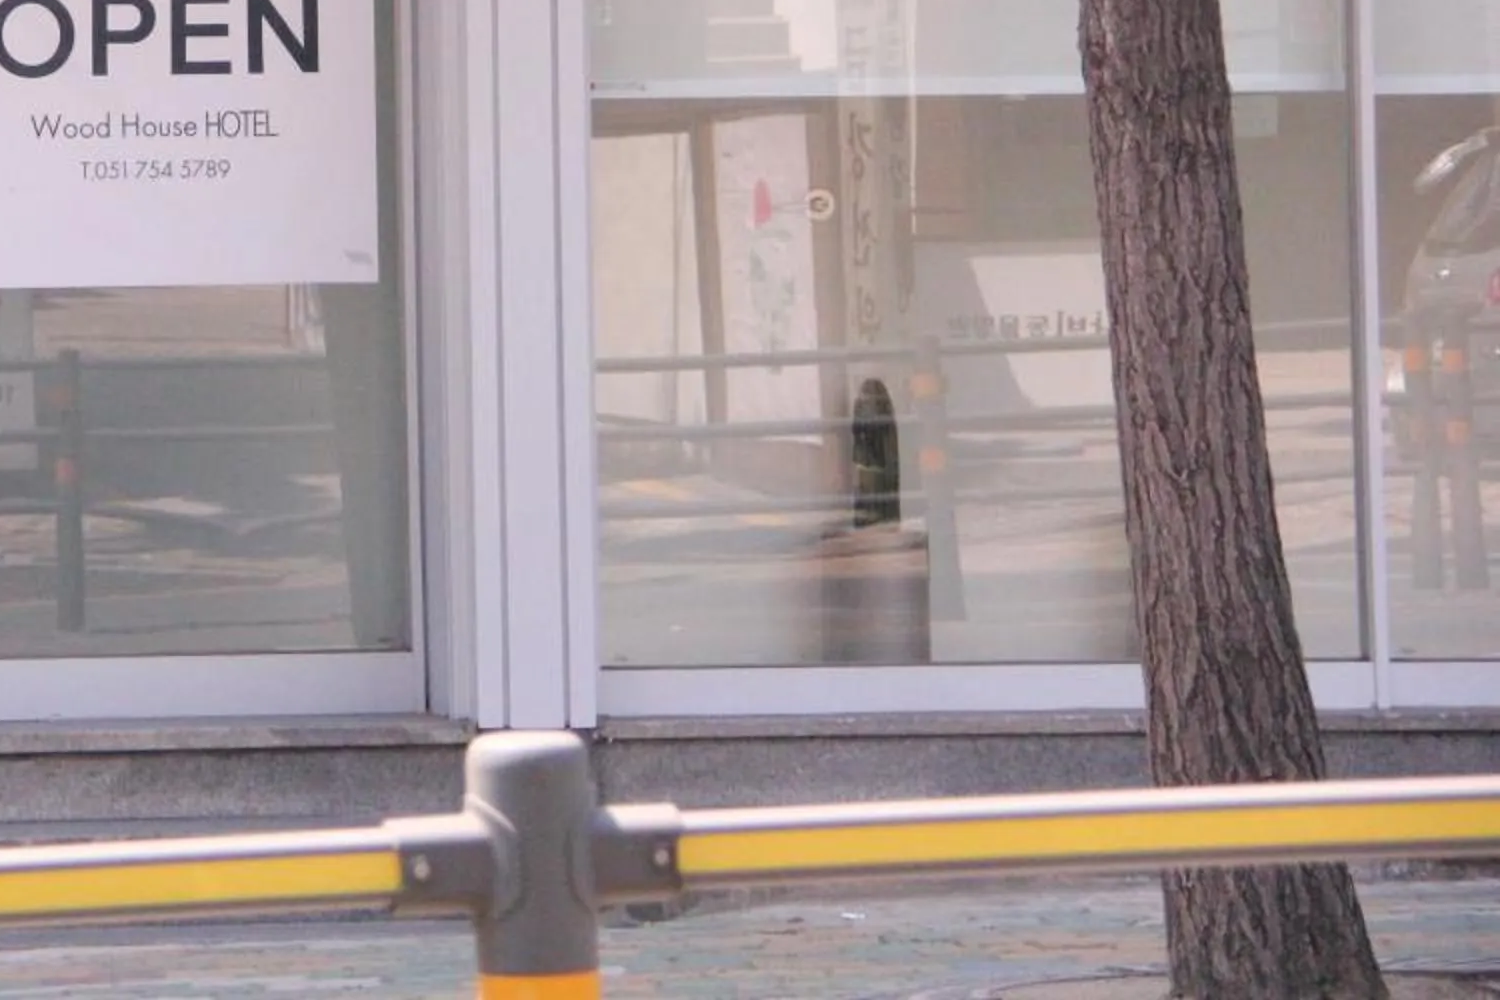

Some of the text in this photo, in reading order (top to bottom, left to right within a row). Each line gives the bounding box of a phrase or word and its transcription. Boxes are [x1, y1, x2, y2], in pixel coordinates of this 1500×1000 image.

[30, 109, 280, 139] Wood House HOTEL
[134, 159, 173, 180] 754
[179, 158, 232, 180] 5789
